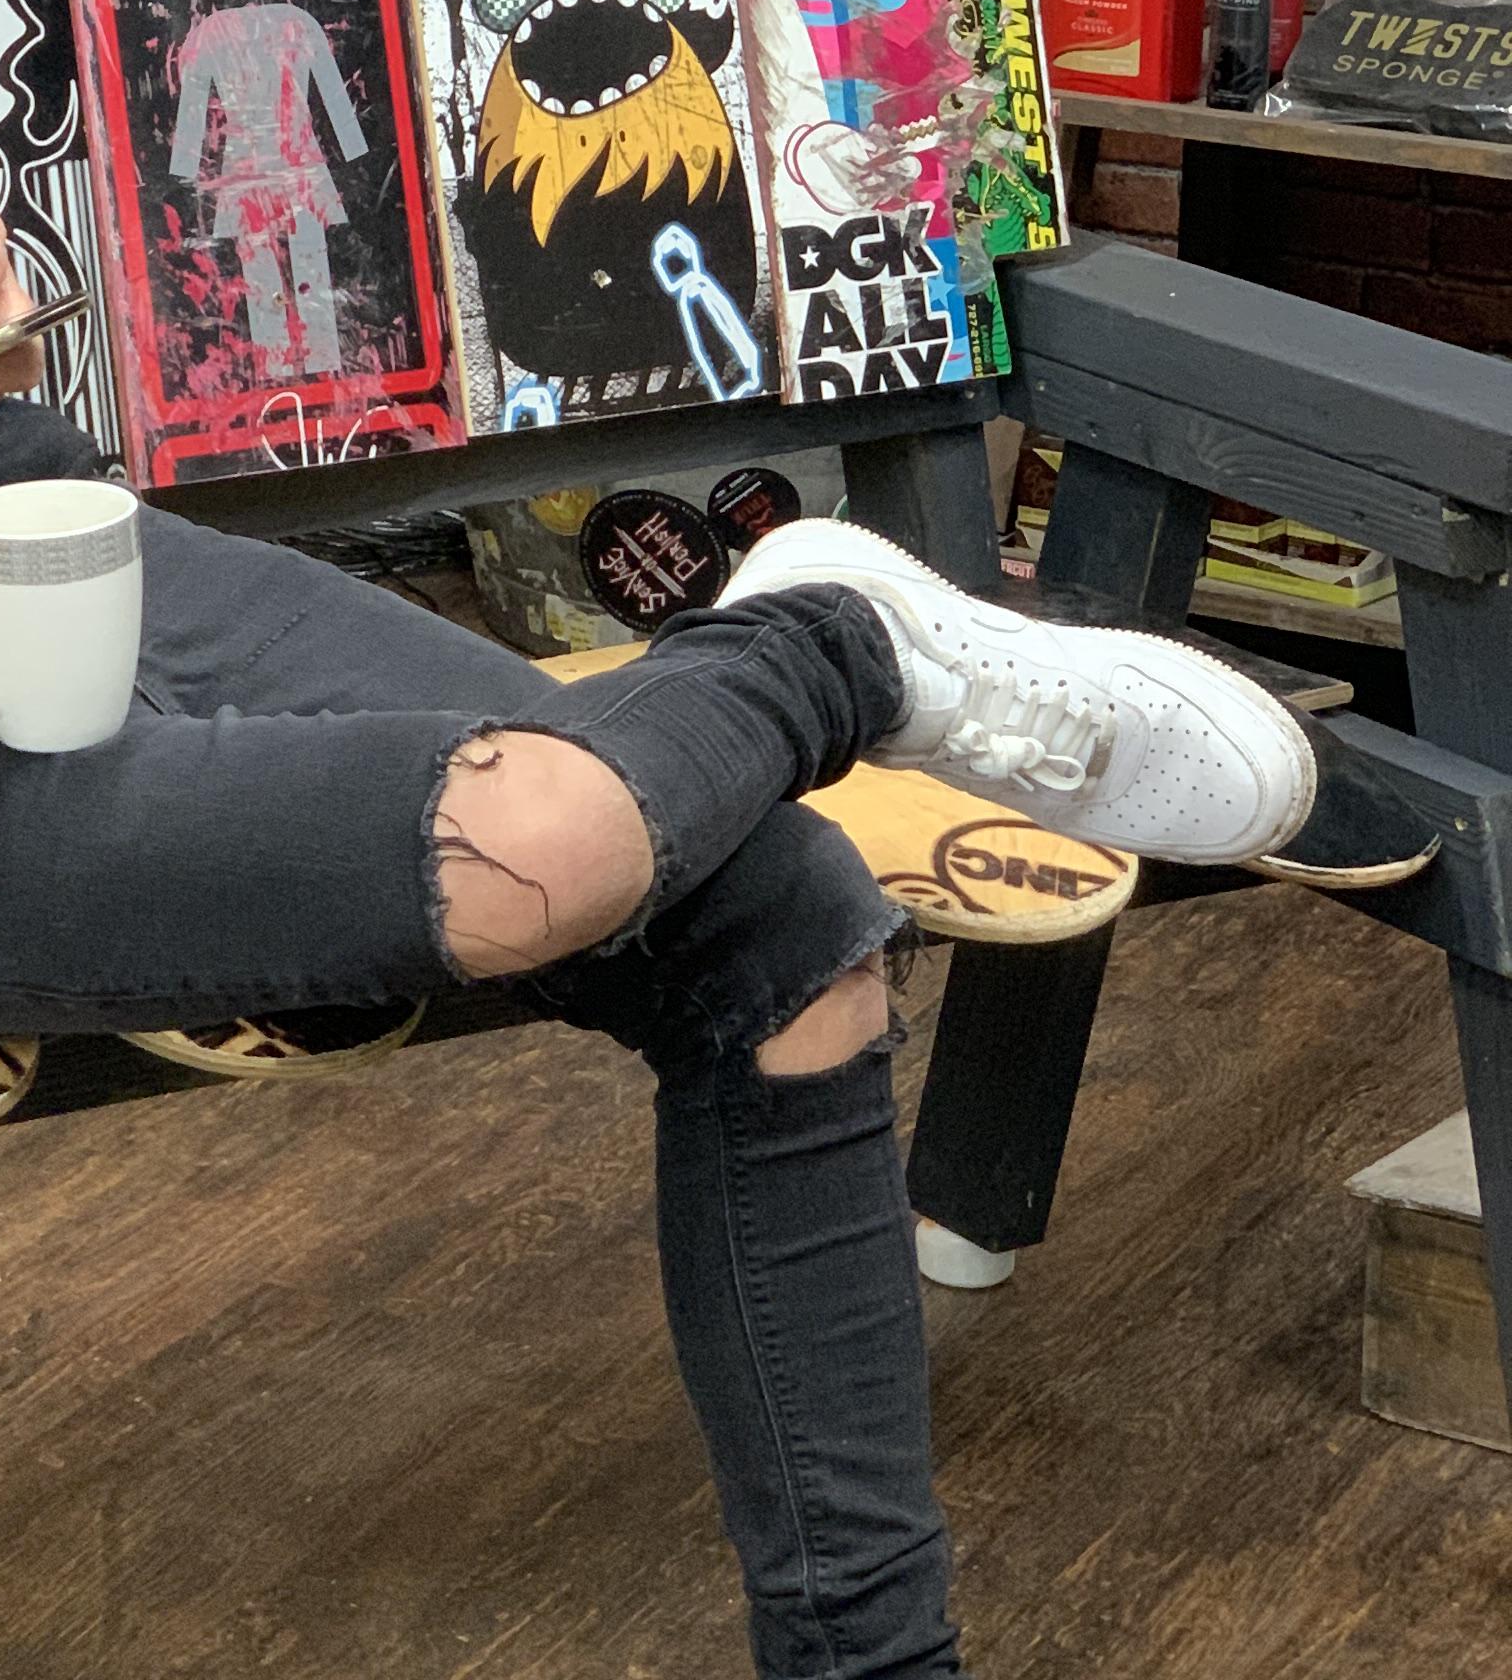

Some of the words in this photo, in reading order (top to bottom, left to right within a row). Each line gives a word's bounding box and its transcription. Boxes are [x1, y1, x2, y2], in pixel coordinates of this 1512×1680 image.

[1092, 0, 1128, 11] POWDER
[1071, 22, 1114, 35] CLASSIC
[1333, 54, 1488, 90] SPONGE
[782, 207, 938, 292] DGK
[798, 277, 949, 361] ALL
